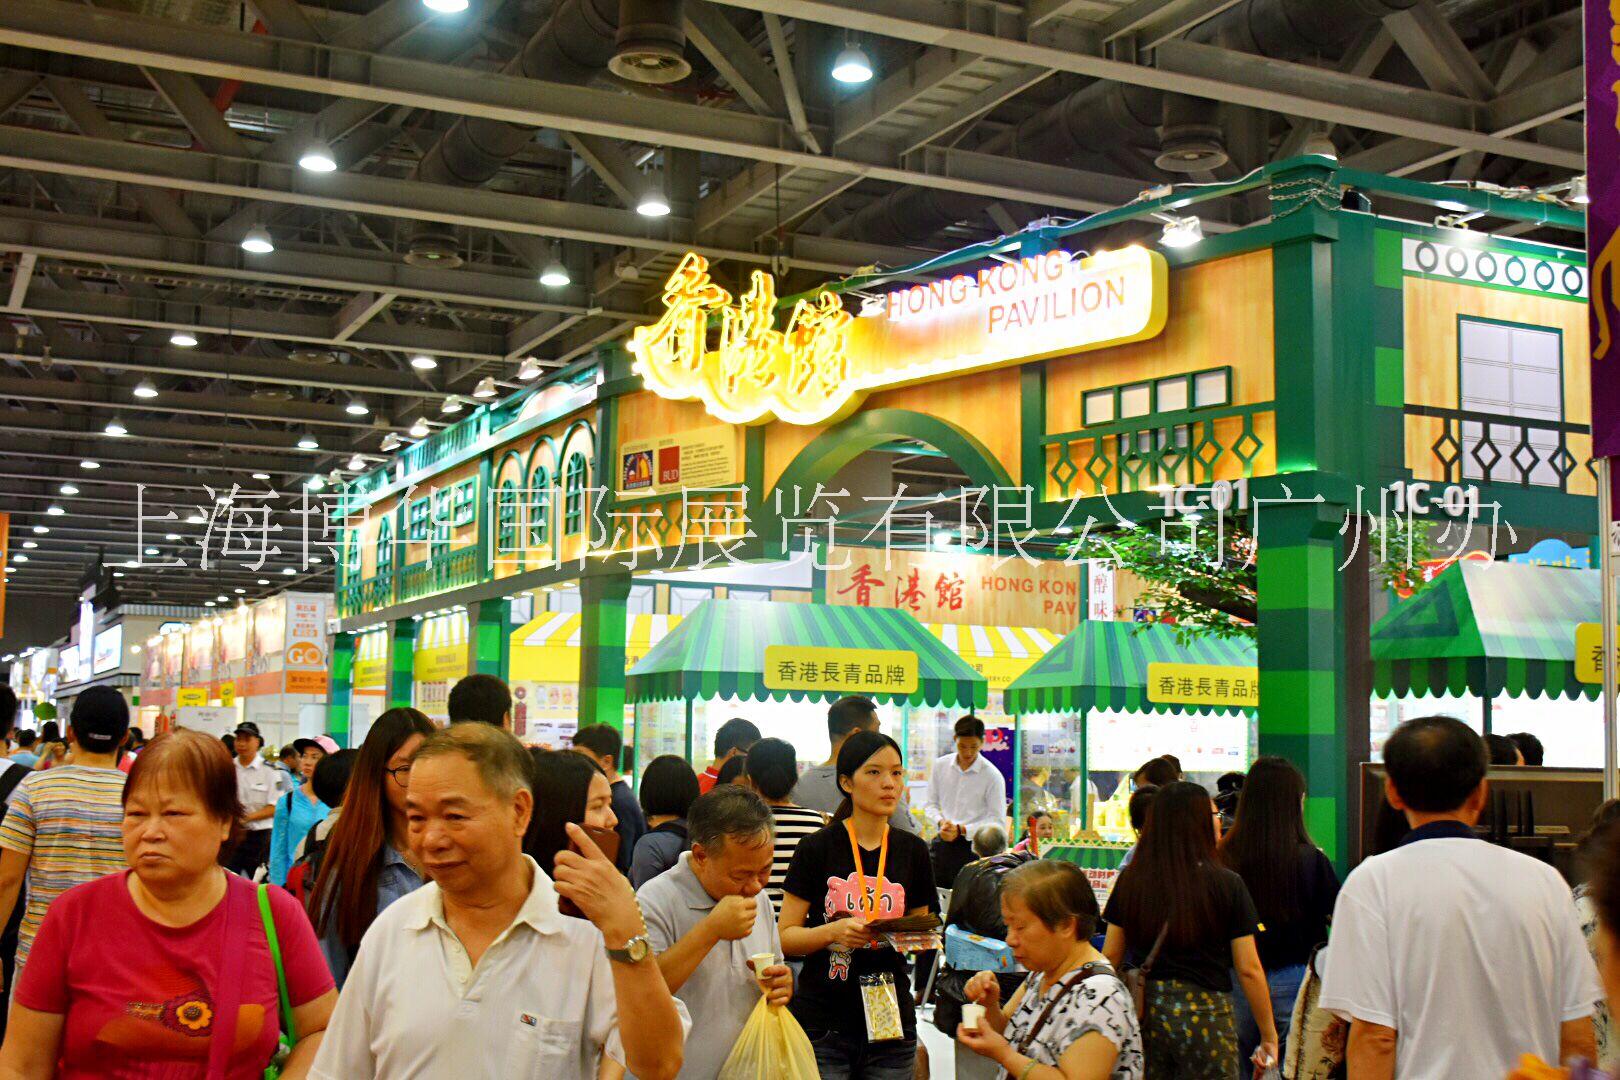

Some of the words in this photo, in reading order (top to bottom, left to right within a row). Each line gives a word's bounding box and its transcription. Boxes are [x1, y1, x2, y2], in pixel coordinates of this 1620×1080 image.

[887, 274, 968, 319] HONG
[978, 249, 1064, 298] KONG
[989, 276, 1125, 333] PAVILION
[663, 469, 679, 481] BUD
[1159, 478, 1248, 517] 1C-01
[1389, 480, 1479, 519] 1C-01
[837, 564, 966, 611] 香港館
[982, 575, 1034, 593] HONG
[1039, 579, 1077, 596] KON
[288, 647, 322, 665] GO
[778, 660, 906, 686] 香港長青品牌
